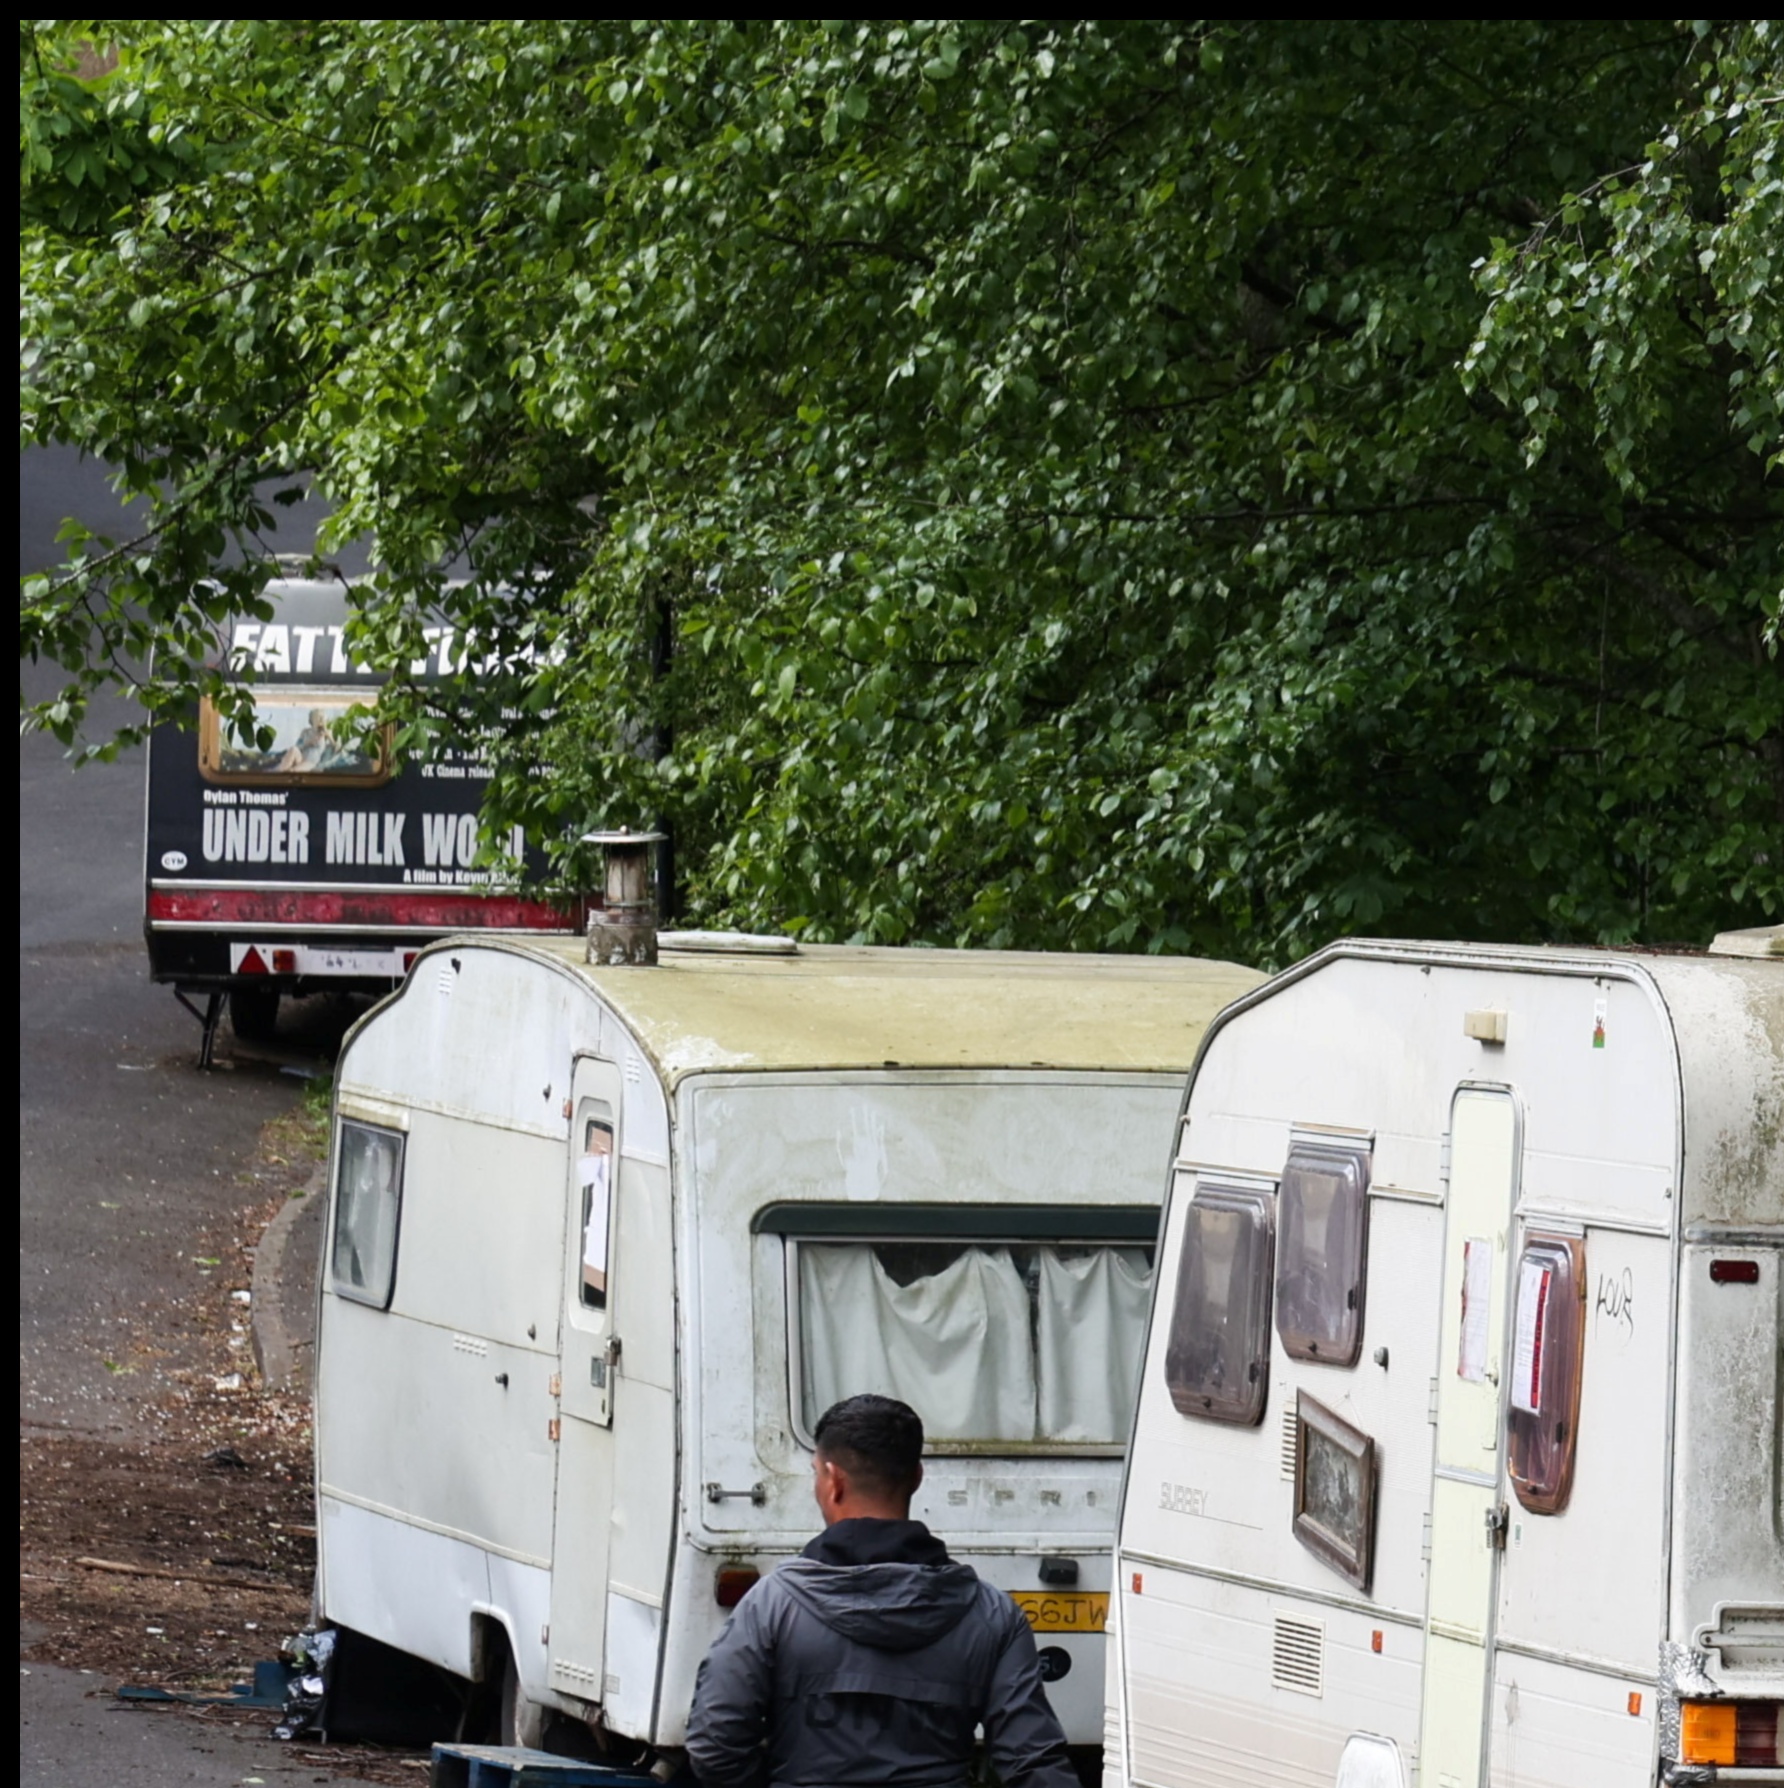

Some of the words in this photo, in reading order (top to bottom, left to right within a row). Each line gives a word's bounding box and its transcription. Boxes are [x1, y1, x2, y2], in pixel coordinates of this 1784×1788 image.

[230, 623, 373, 675] FATT
[436, 763, 466, 777] Cinema
[203, 789, 237, 805] Dylan
[239, 790, 289, 805] Thomas'
[203, 808, 310, 864] UNDER
[326, 811, 405, 867] MILK
[422, 813, 523, 868] WOD
[403, 869, 412, 883] A
[413, 869, 437, 884] film
[439, 869, 453, 885] by
[1160, 1481, 1209, 1516] SURREY
[1018, 1598, 1106, 1627] 66JW
